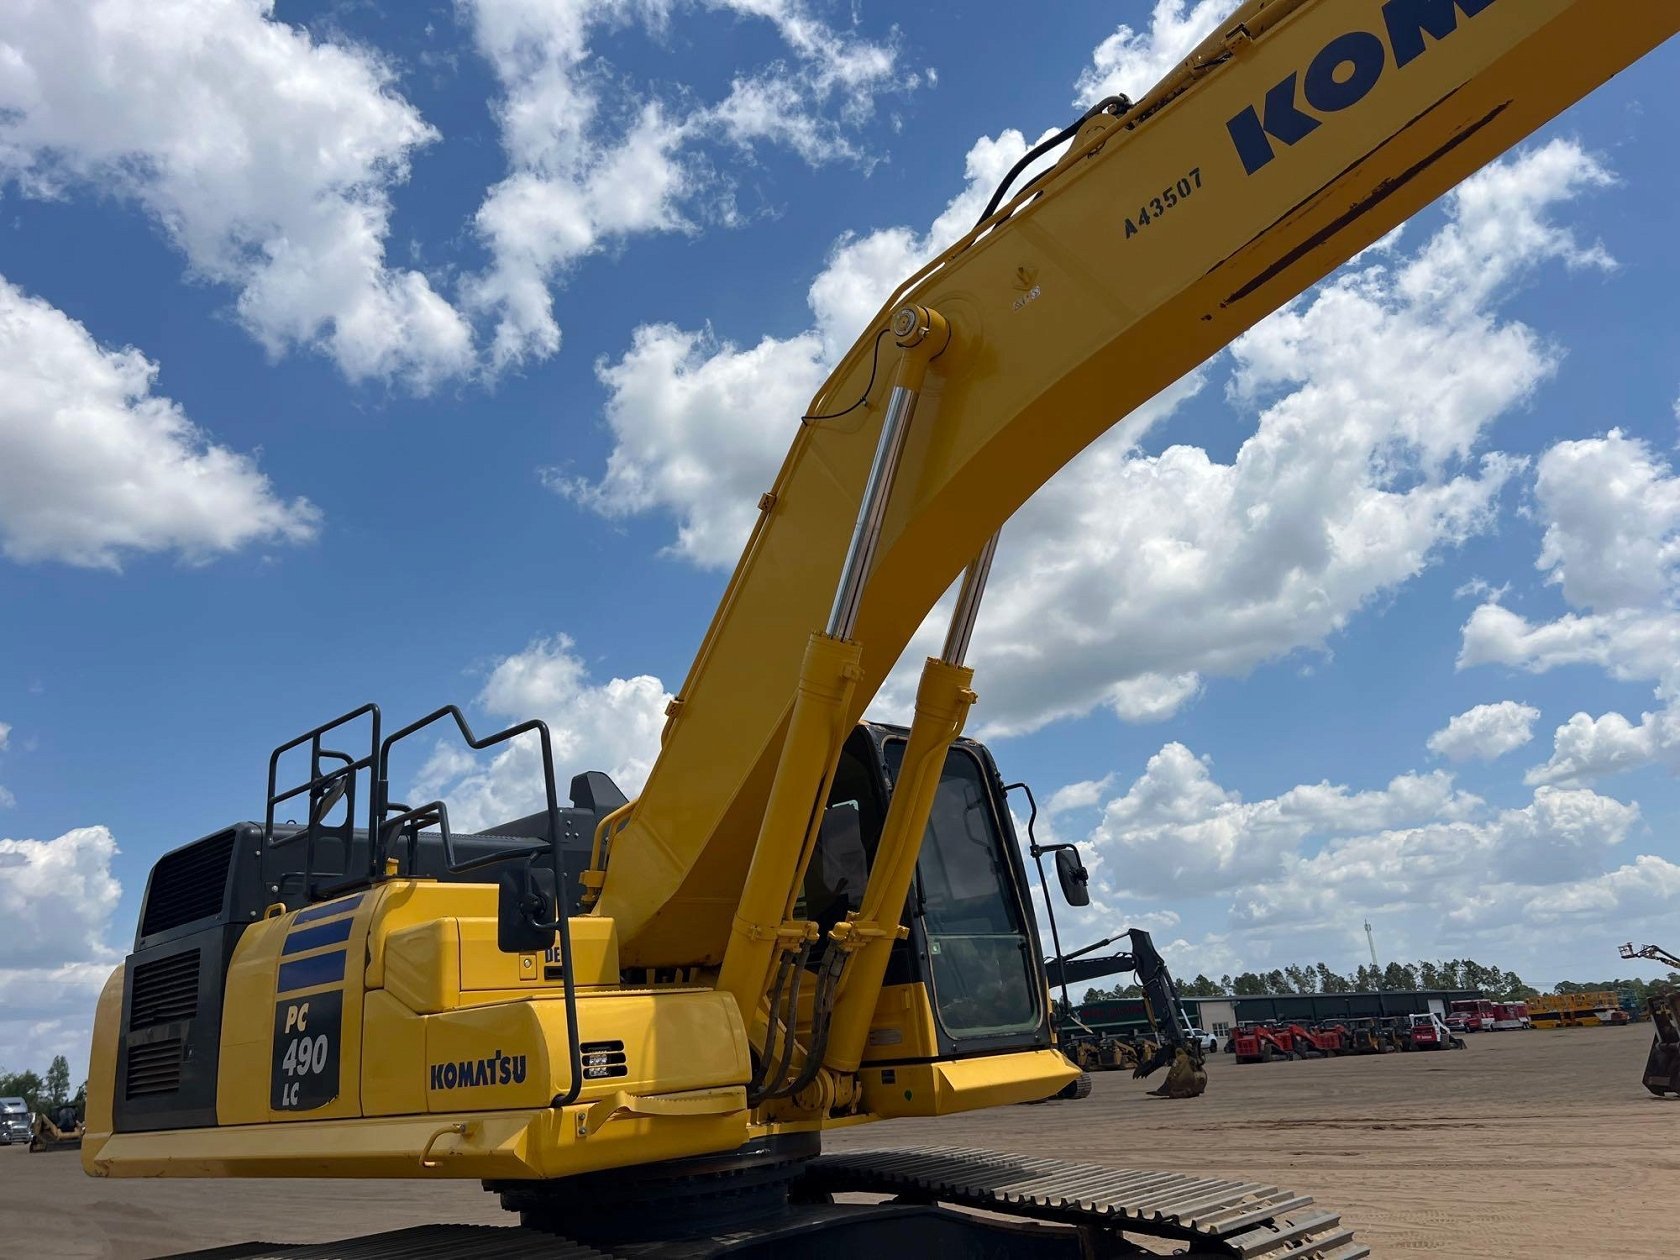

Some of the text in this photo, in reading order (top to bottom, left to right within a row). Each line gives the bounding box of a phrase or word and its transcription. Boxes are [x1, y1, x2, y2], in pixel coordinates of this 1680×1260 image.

[1124, 167, 1202, 240] A43507
[284, 1002, 309, 1034] PC
[282, 1034, 328, 1077] 490
[431, 1050, 526, 1090] KOMATSU
[282, 1082, 300, 1106] LC
